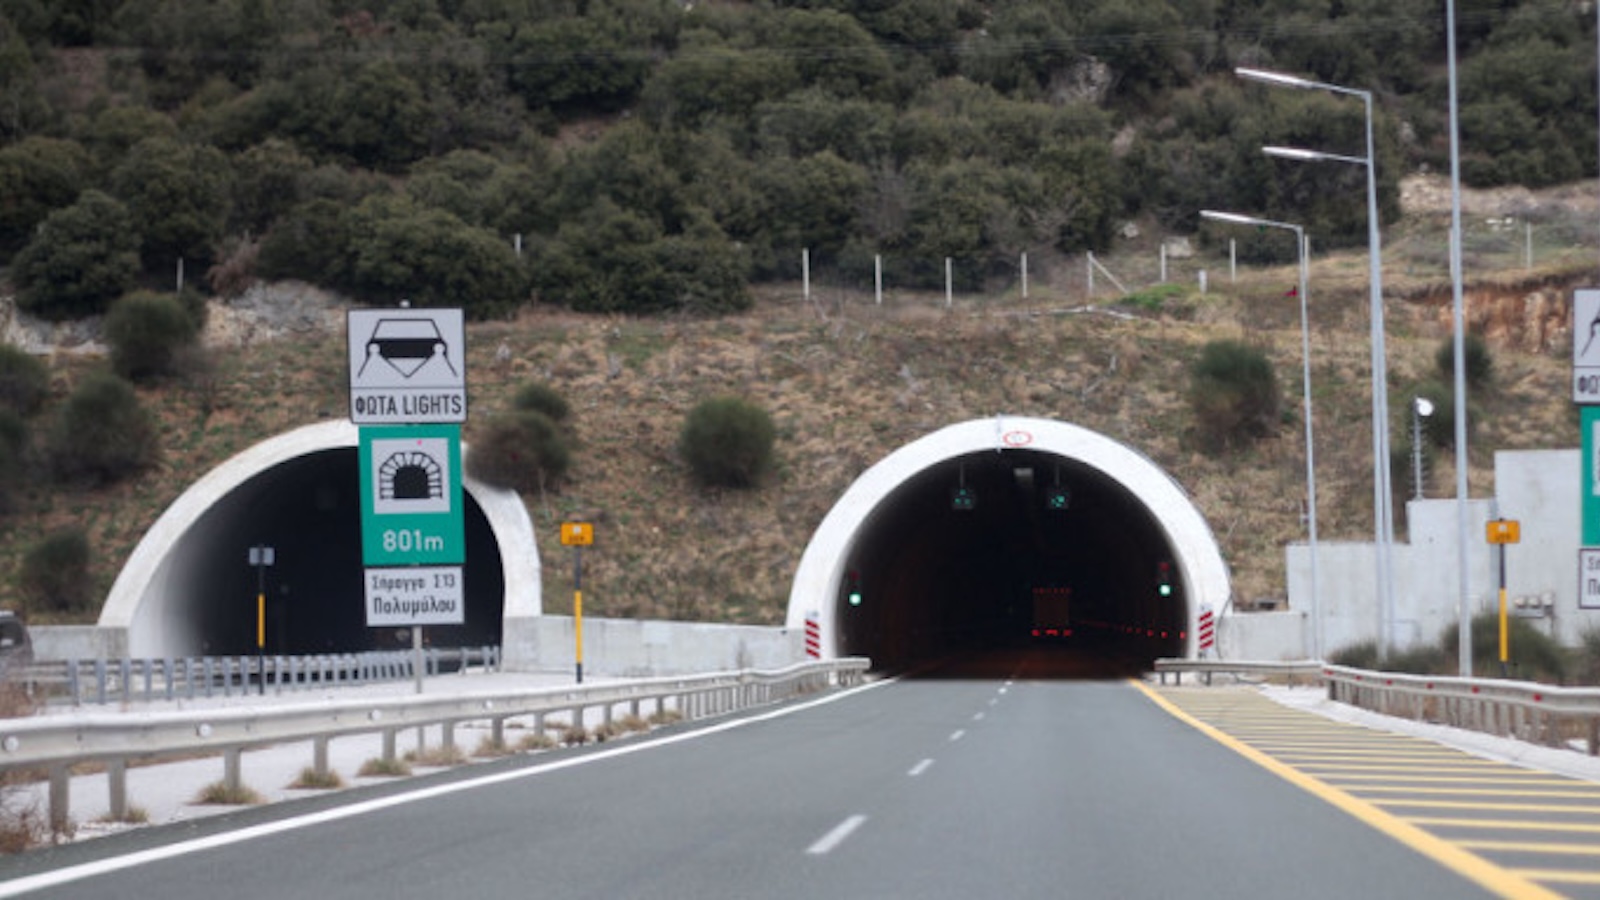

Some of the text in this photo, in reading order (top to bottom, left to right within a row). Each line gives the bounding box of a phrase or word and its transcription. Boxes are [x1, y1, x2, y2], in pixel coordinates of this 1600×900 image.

[355, 393, 462, 416] ΦΩΤΑ LIGHTS
[382, 529, 444, 552] 801m
